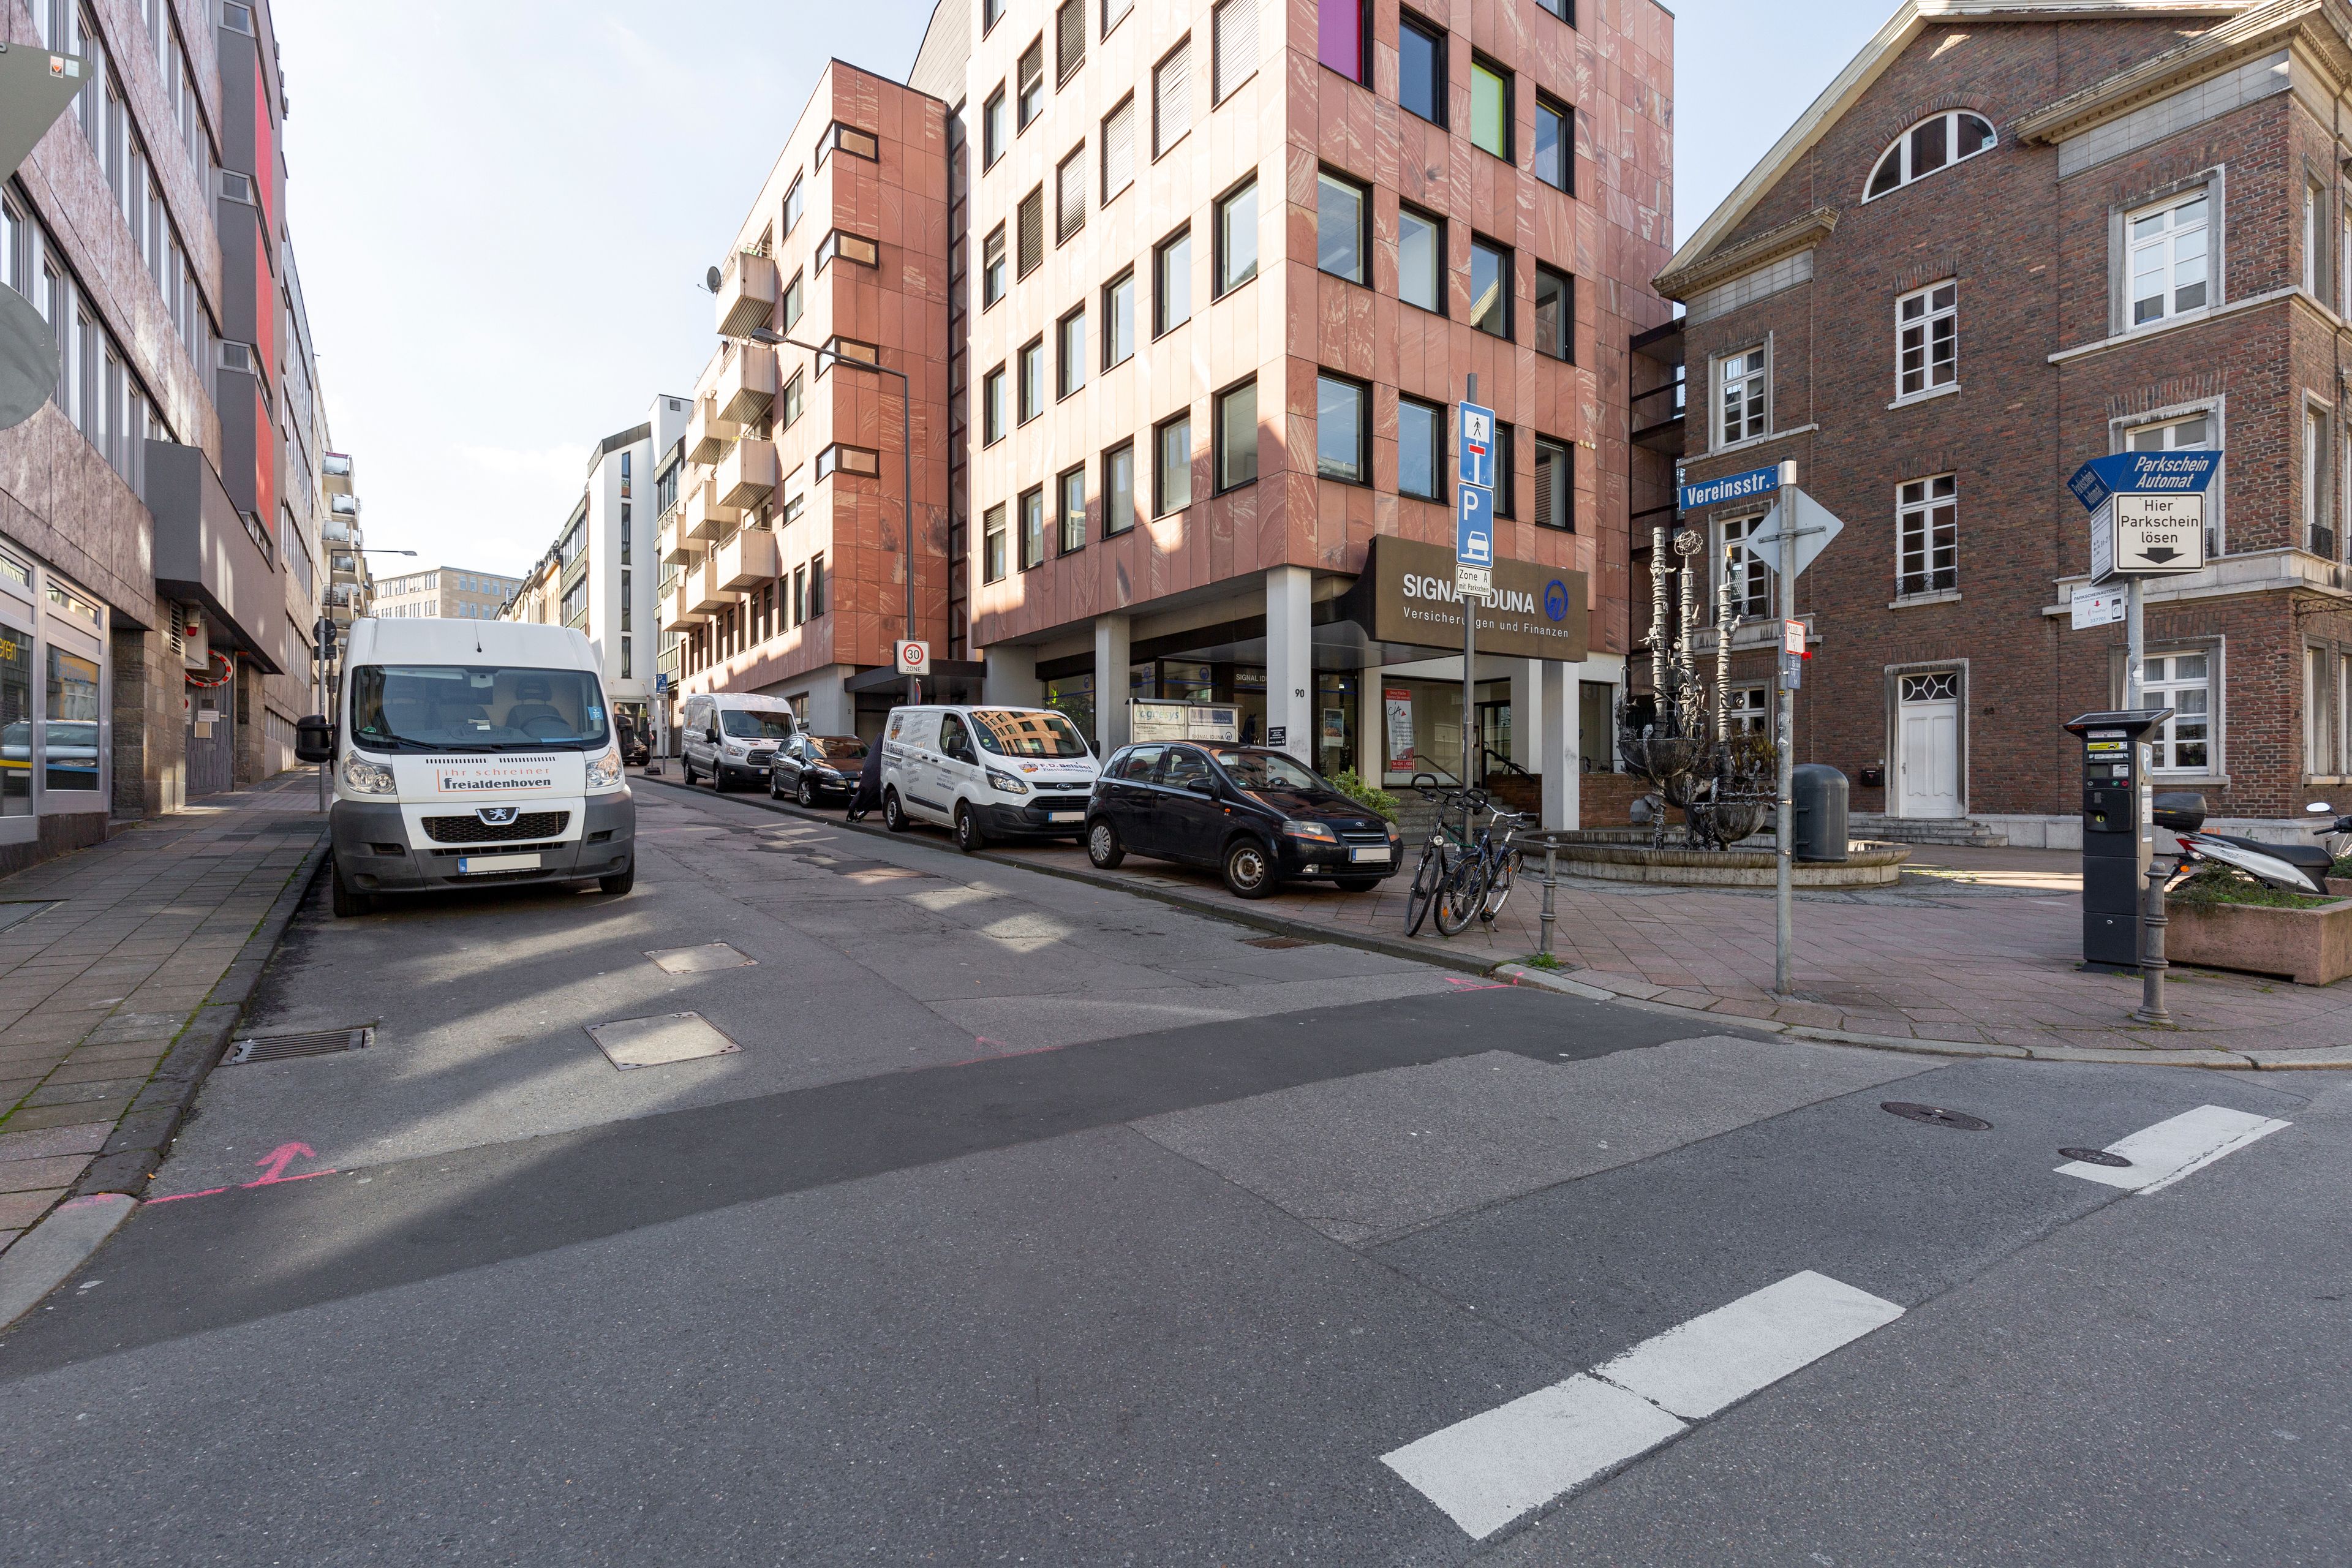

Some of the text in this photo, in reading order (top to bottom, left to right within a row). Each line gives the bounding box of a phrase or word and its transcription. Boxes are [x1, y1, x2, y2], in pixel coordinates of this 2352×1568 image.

[2134, 456, 2209, 472] Parkschein
[2071, 470, 2096, 495] Parkschein
[2135, 473, 2194, 488] Automat
[1687, 474, 1770, 505] Vereinsstr.
[2083, 483, 2104, 506] Automat
[1464, 490, 1479, 521] P
[2144, 499, 2174, 511] Hier
[2121, 515, 2199, 527] Parkschein
[2141, 531, 2178, 543] lösen
[1459, 569, 1488, 584] Zone A
[1403, 573, 1476, 605] SIGNA
[1468, 584, 1490, 594] Parkschein
[2074, 587, 2122, 601] PARKSCHEINAUTOMAT
[1403, 606, 1569, 638] Versicherugen und Finanzen
[908, 649, 919, 660] 30
[1295, 688, 1305, 698] 90
[475, 767, 549, 776] schreiner
[444, 777, 551, 790] freialdenhoven
